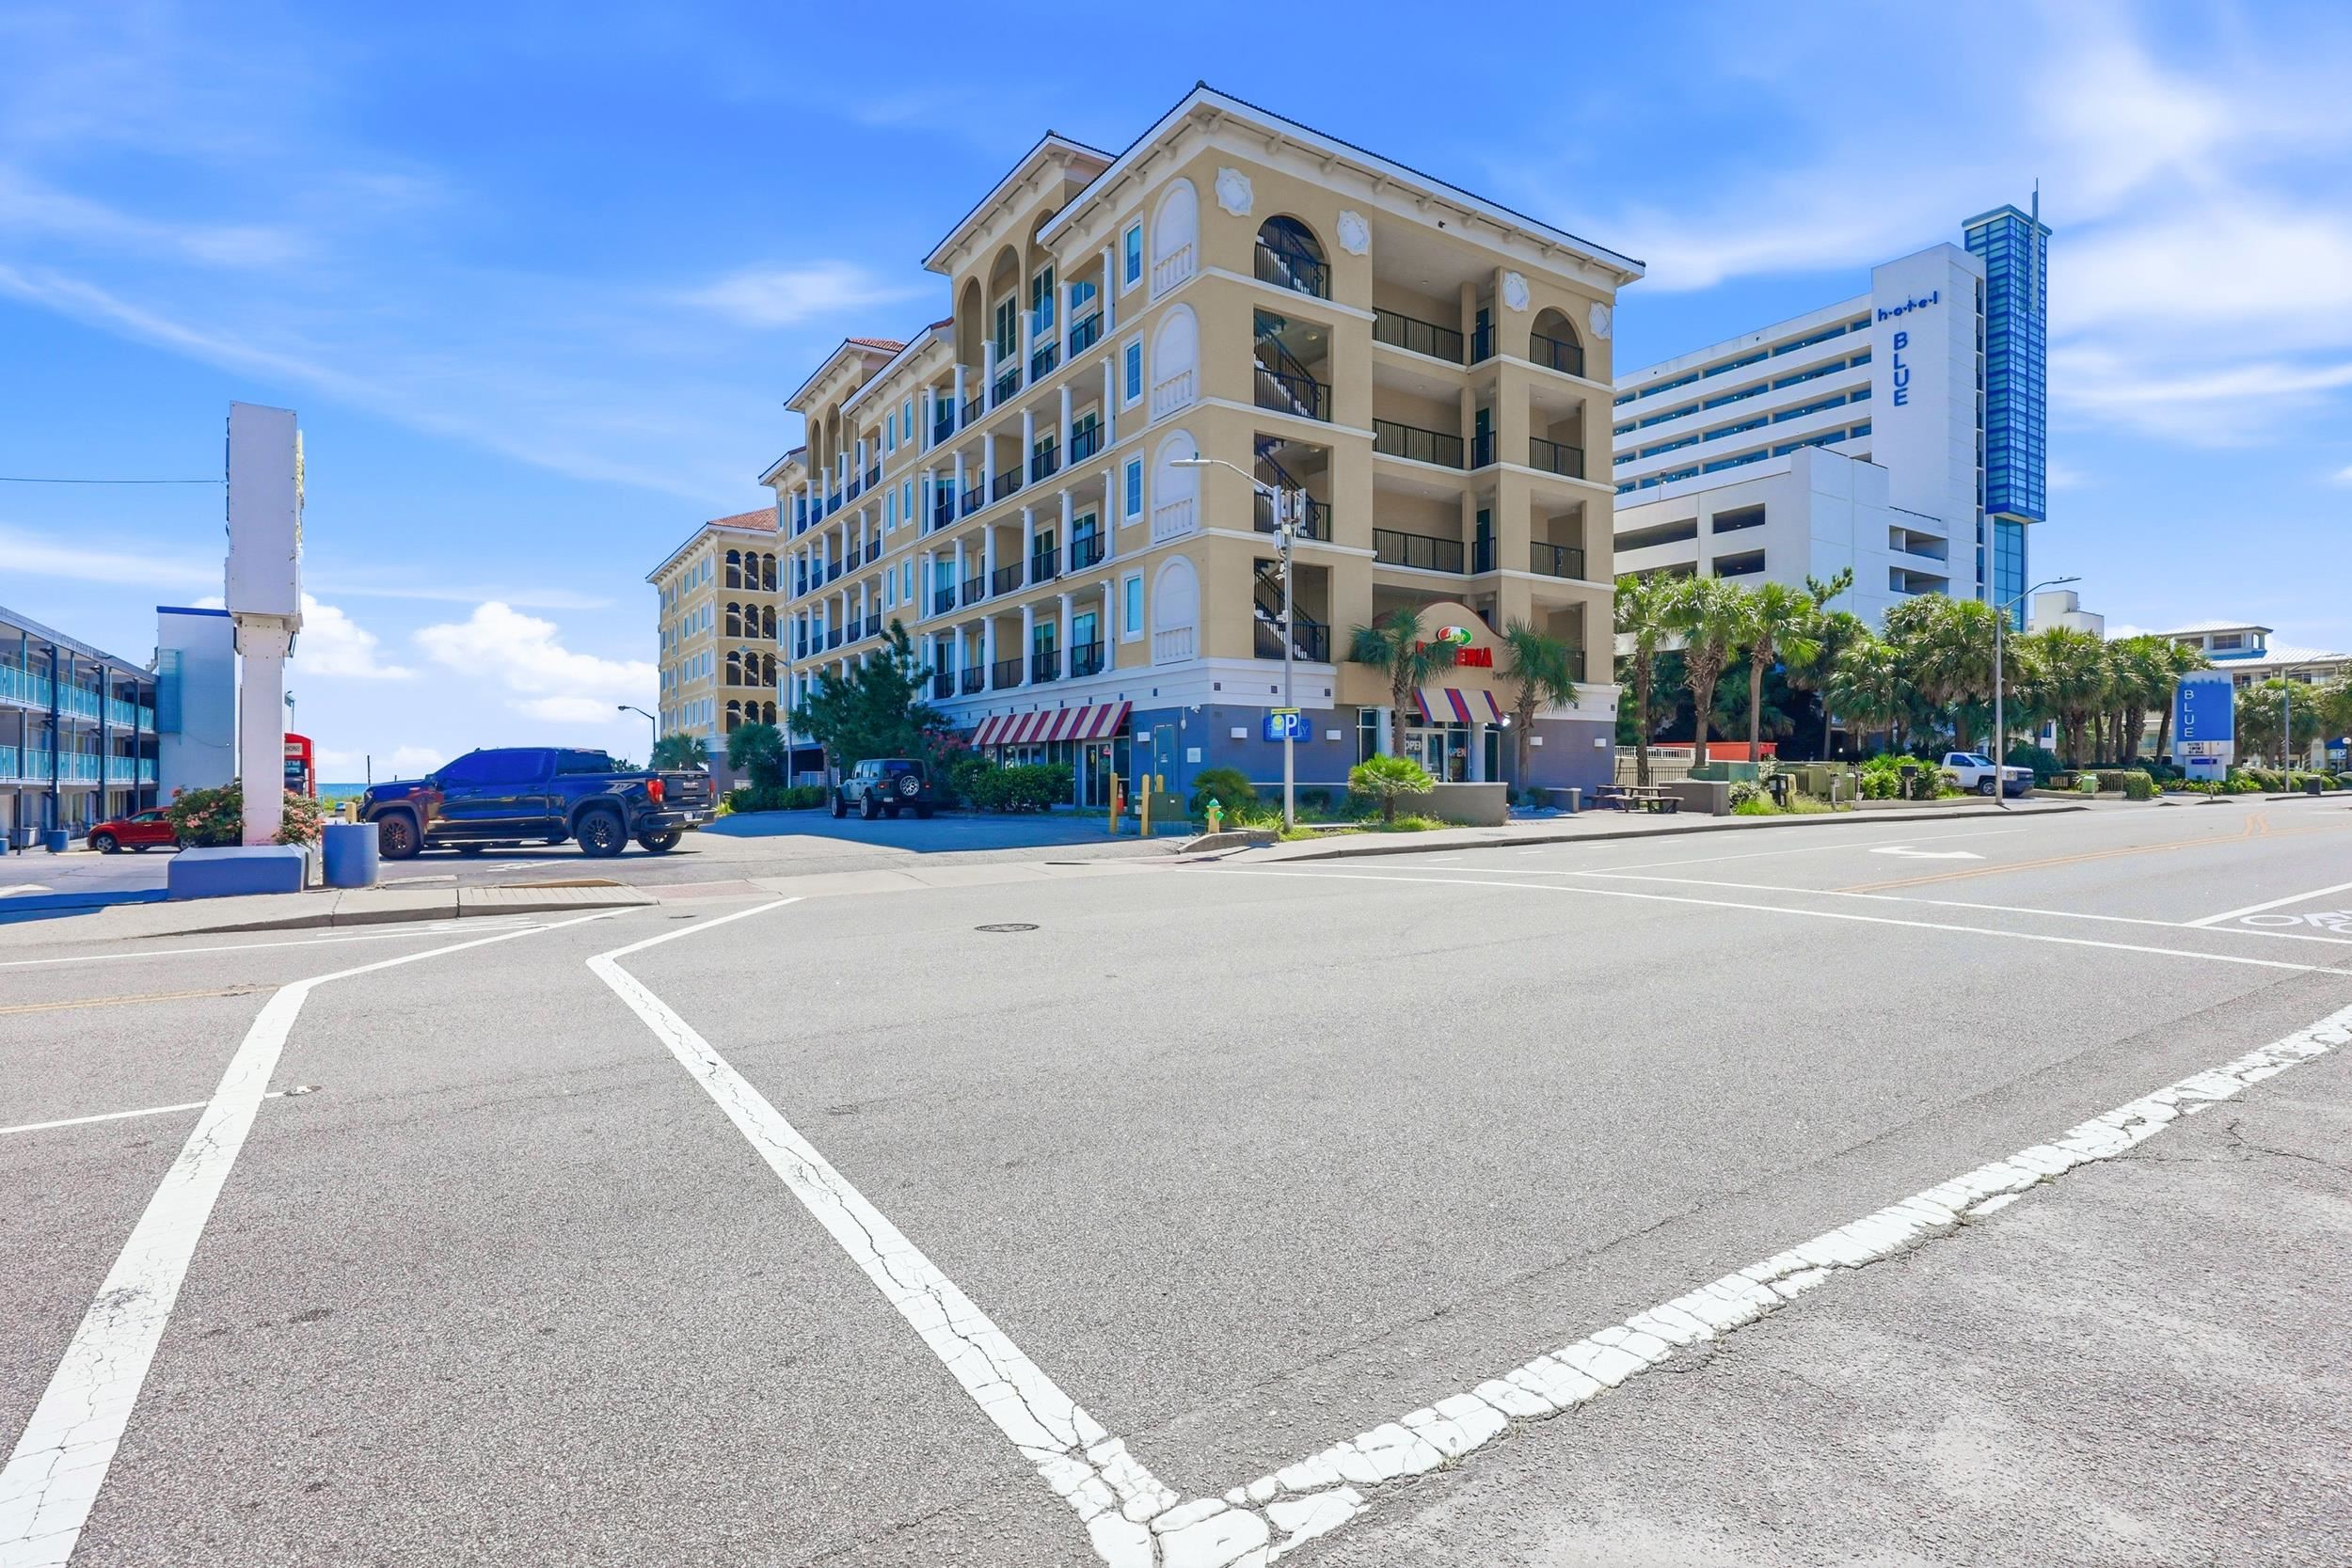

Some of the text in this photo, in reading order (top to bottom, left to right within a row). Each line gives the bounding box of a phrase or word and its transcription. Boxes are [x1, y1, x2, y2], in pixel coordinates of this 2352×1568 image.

[1878, 291, 1938, 322] hotel
[1893, 331, 1909, 406] BLUE
[1285, 714, 1297, 736] P
[2184, 689, 2195, 737] BLUE
